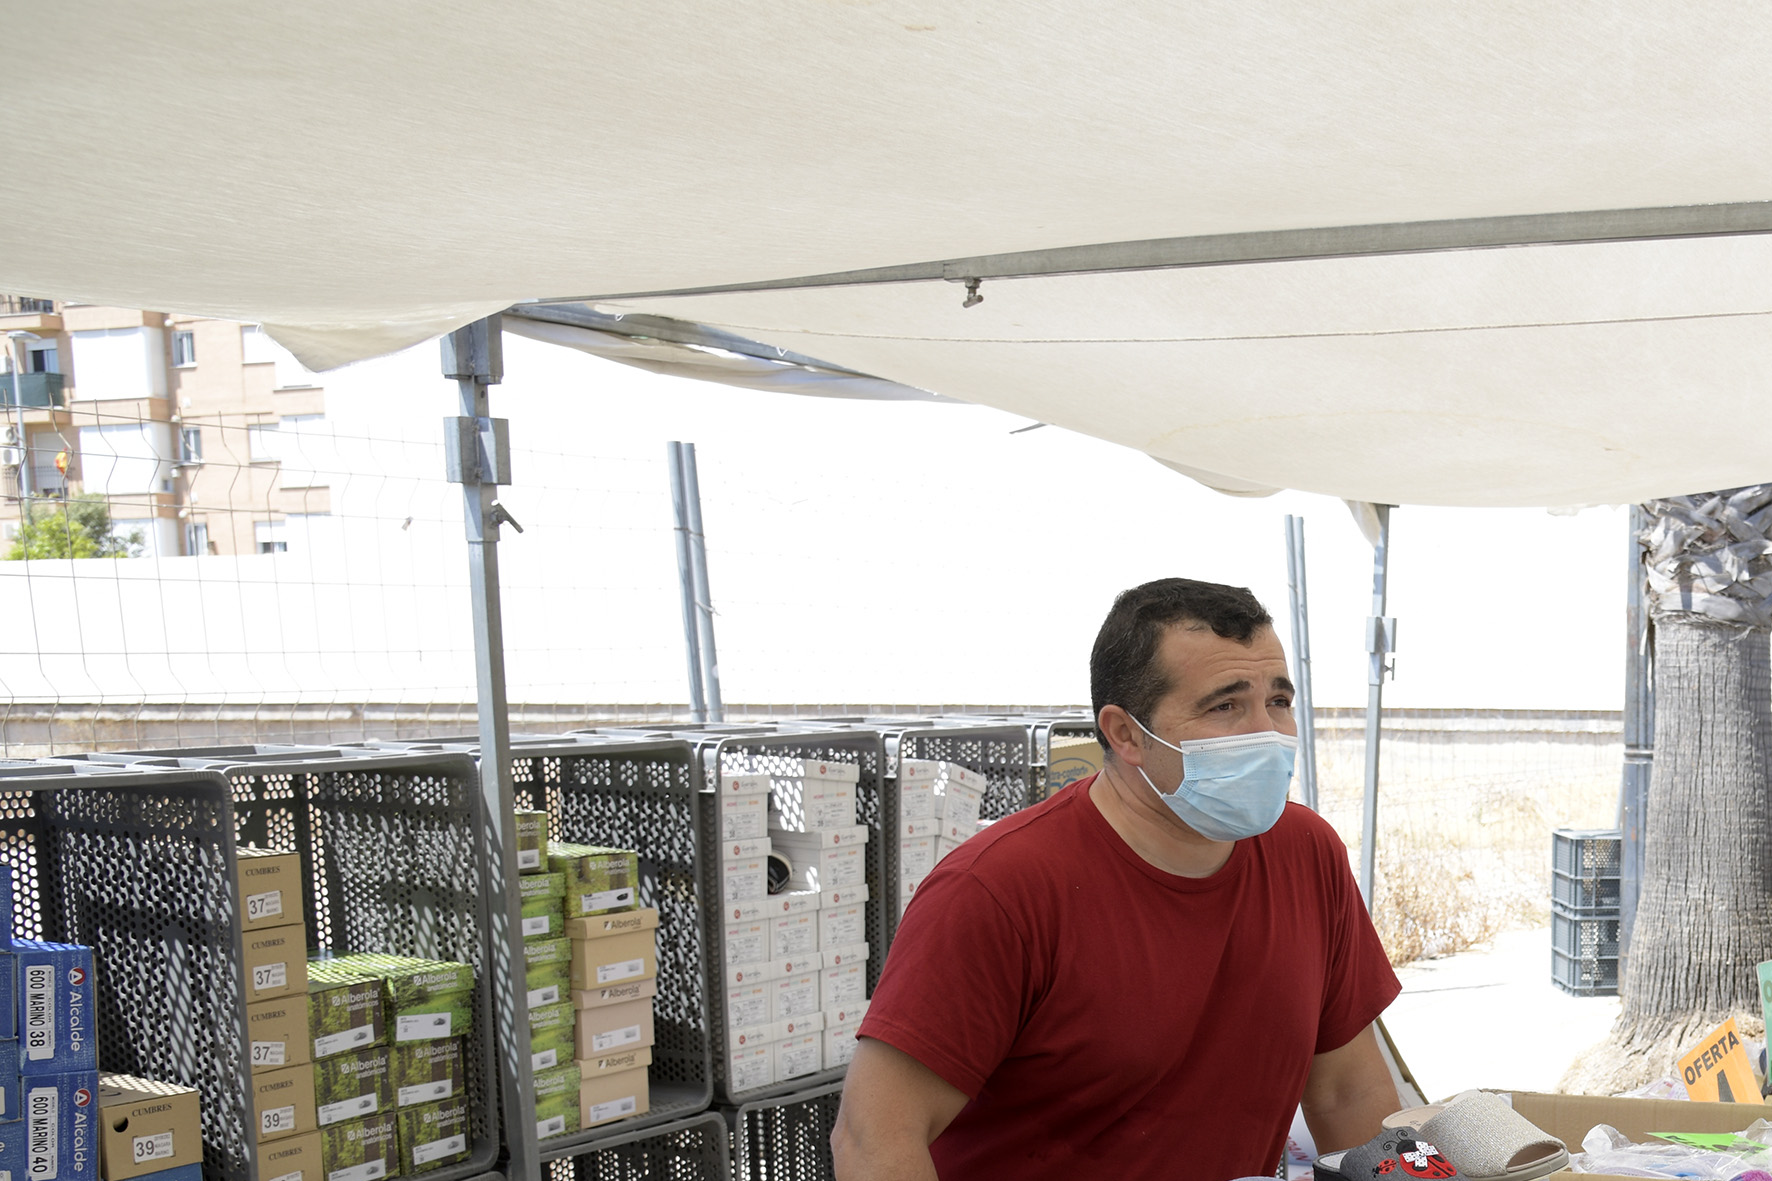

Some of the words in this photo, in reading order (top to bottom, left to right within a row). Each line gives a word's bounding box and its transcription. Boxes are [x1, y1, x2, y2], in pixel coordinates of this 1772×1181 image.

[245, 866, 280, 876] CUMBRES
[249, 898, 265, 915] 37
[251, 937, 285, 950] CUMBRES
[30, 969, 46, 989] 600
[256, 969, 271, 986] 37
[421, 972, 458, 986] Alberola
[341, 989, 380, 1006] Alberola
[30, 993, 46, 1027] MARINO
[251, 1009, 287, 1022] CUMBRES
[69, 991, 85, 1052] Alcalde
[30, 1031, 46, 1047] 38
[253, 1046, 270, 1061] 37
[423, 1042, 458, 1057] Alberola
[349, 1056, 386, 1072] Alberola
[1684, 1030, 1740, 1086] OFERTA
[259, 1080, 293, 1093] CUMBRES
[32, 1096, 49, 1115] 600
[131, 1102, 172, 1118] CUMBRES
[264, 1112, 280, 1128] 39
[431, 1107, 467, 1123] Alberola
[31, 1118, 48, 1154] MARINO
[355, 1123, 392, 1140] Alberola
[73, 1112, 88, 1172] Alcalde
[135, 1140, 155, 1158] 39
[268, 1147, 302, 1161] CUMBRES
[32, 1157, 48, 1173] 40
